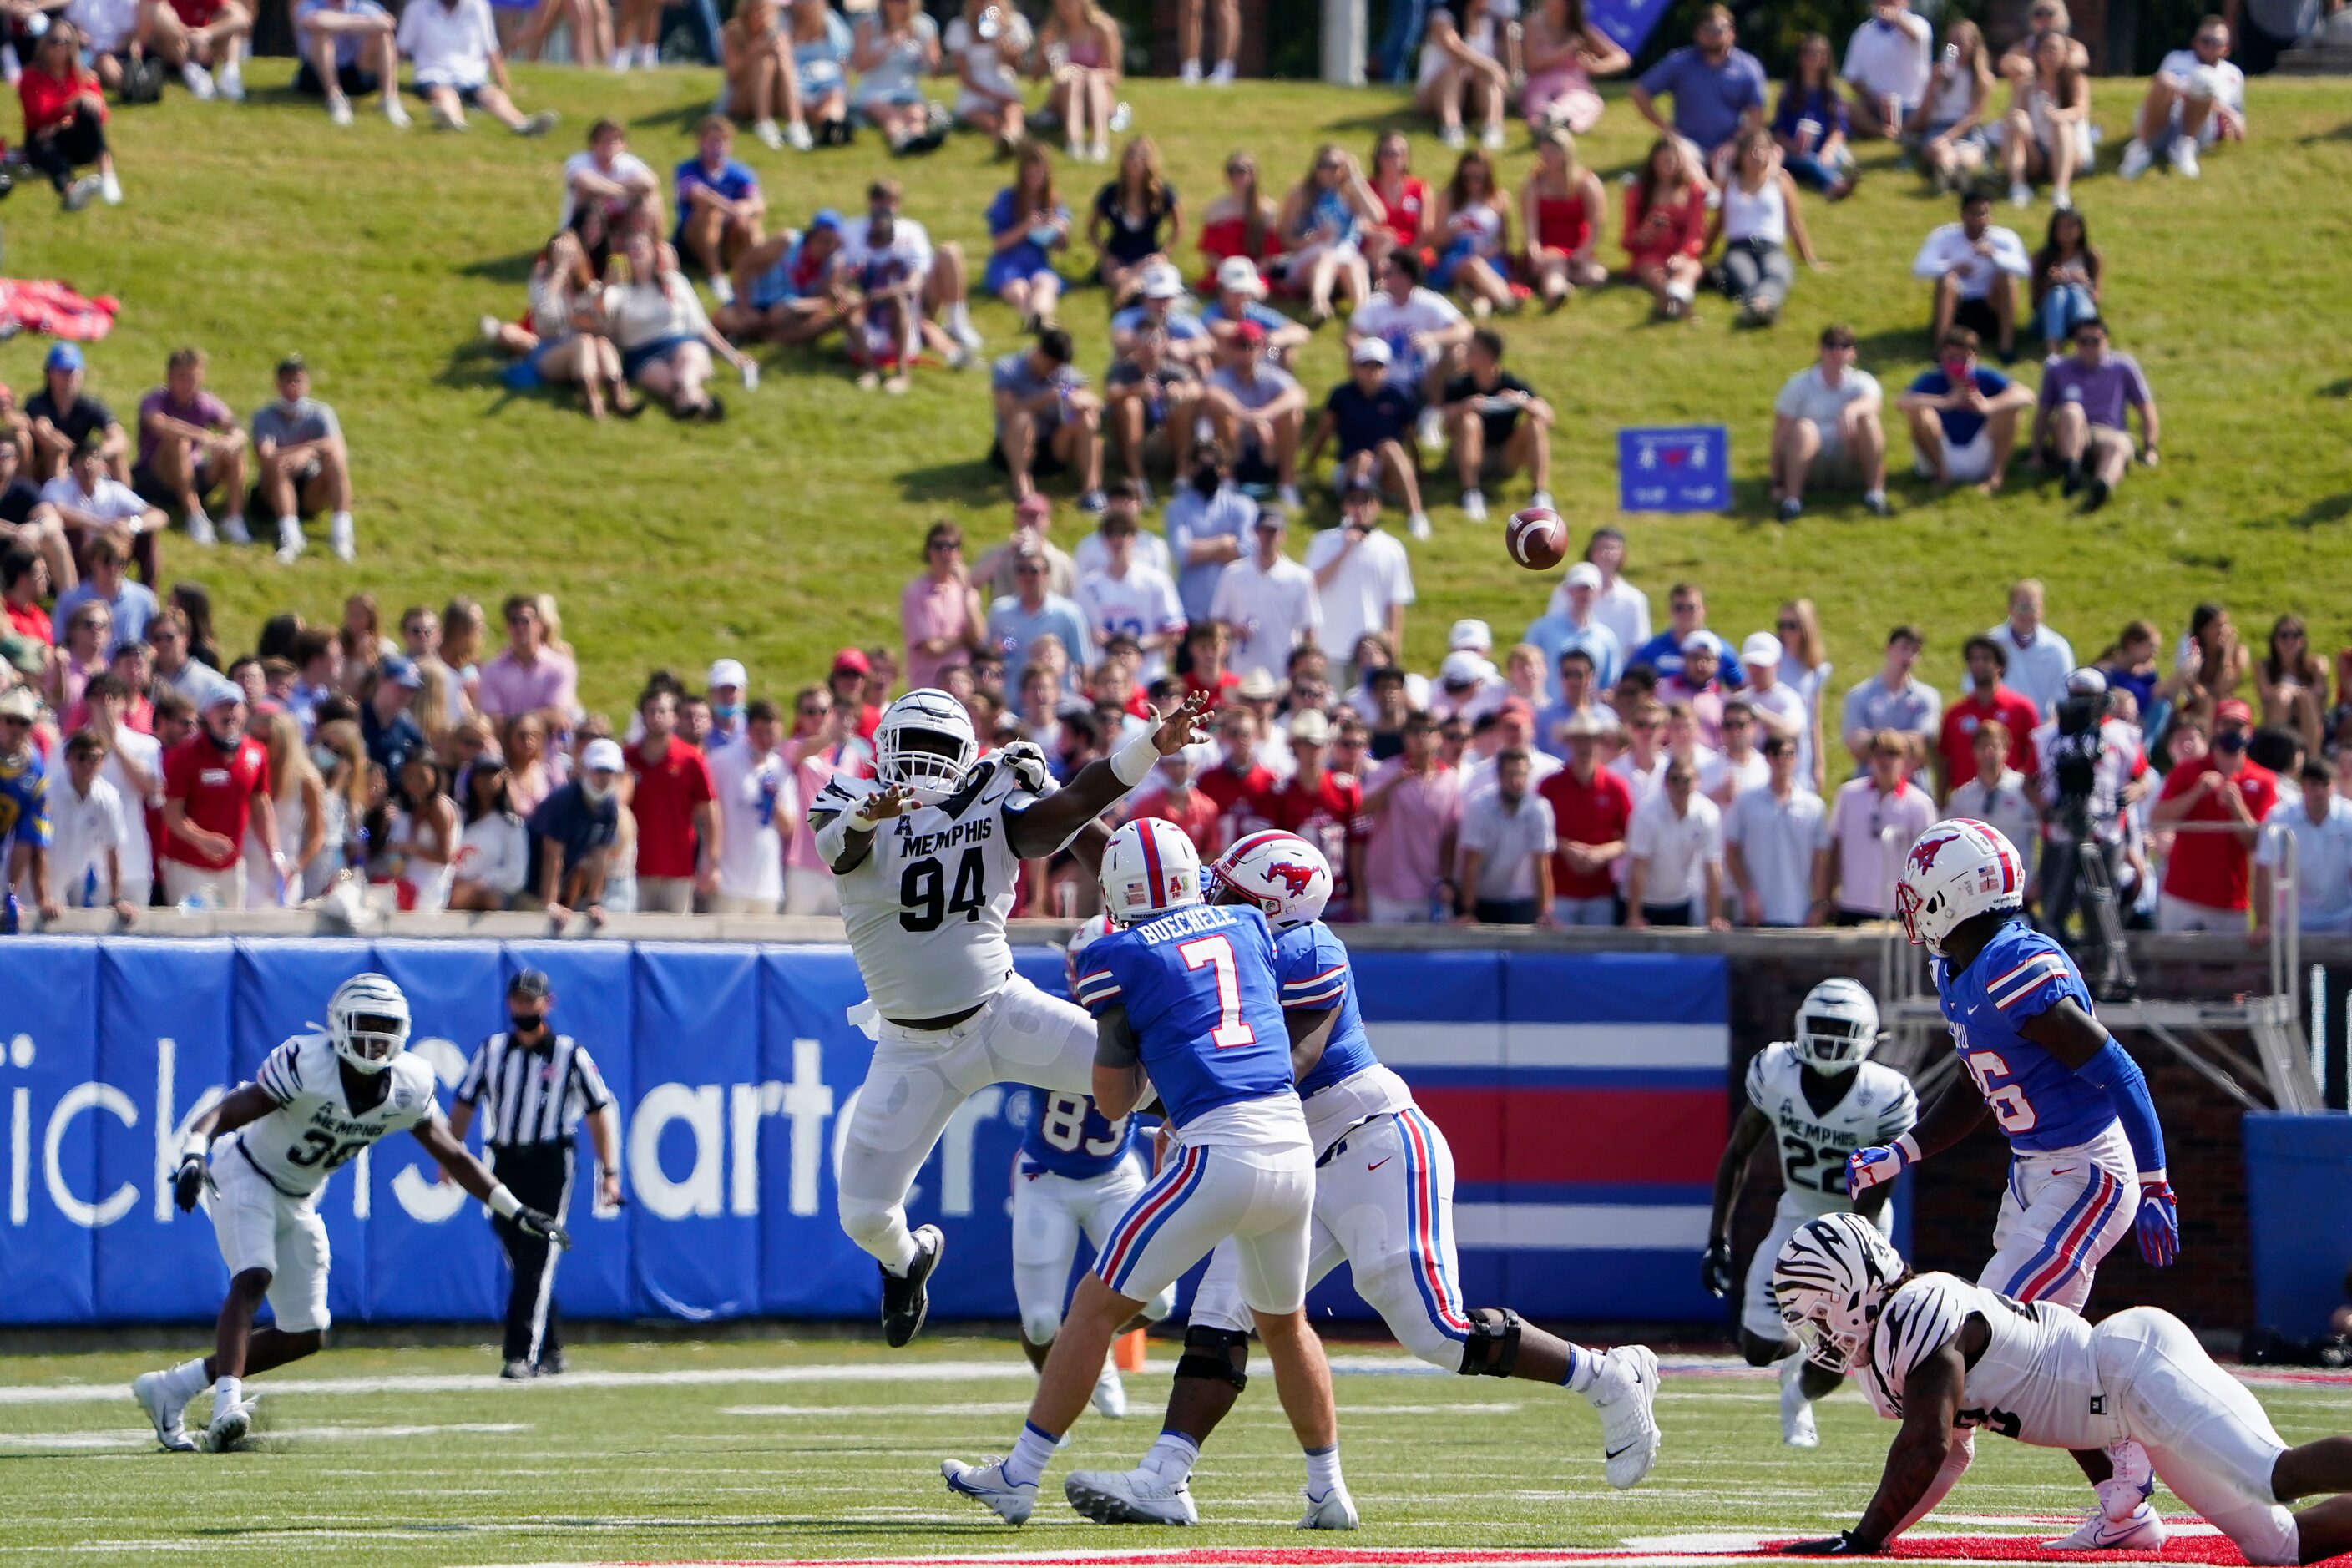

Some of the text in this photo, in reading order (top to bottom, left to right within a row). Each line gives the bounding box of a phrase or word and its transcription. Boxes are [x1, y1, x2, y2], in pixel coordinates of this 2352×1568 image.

[900, 817, 992, 857] MEMPHIS
[1221, 862, 1232, 874] SMU
[899, 846, 986, 933] 94
[1130, 911, 1163, 919] BREONNA
[1137, 906, 1237, 945] BUECHELE
[1176, 933, 1256, 1049] 7
[1959, 1050, 2038, 1134] 6
[319, 1117, 387, 1137] MEMPHIS
[1041, 1090, 1126, 1157] 83
[1779, 1115, 1858, 1147] MEMPHIS
[1783, 1134, 1851, 1196] 22
